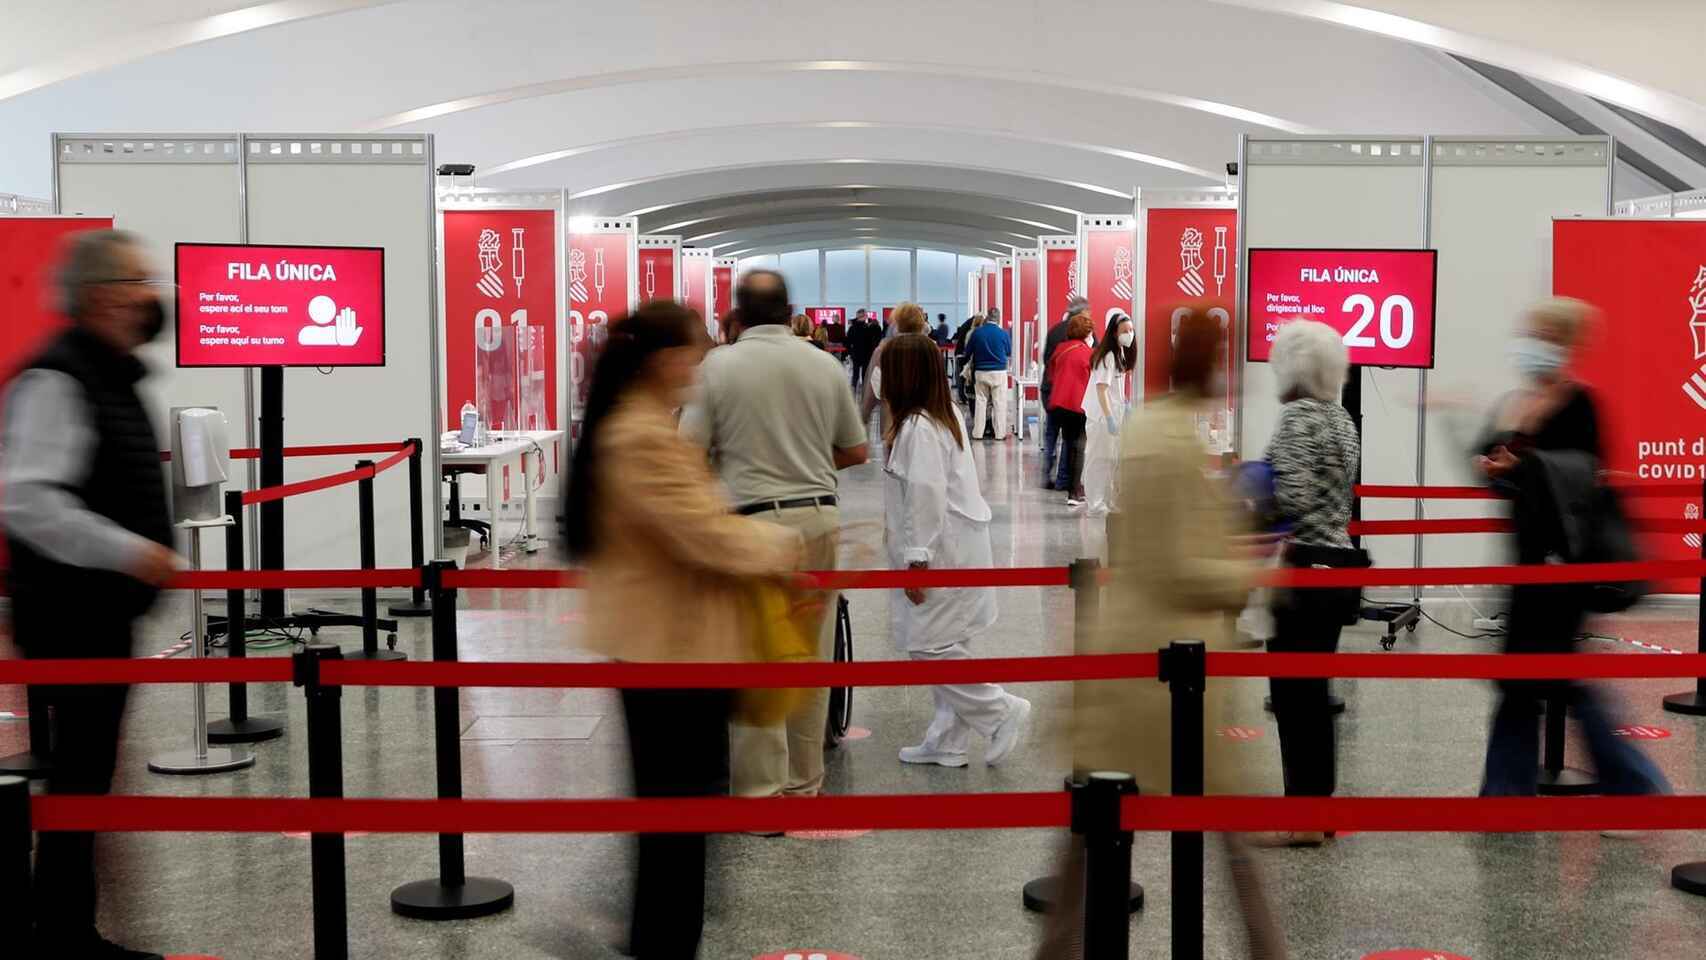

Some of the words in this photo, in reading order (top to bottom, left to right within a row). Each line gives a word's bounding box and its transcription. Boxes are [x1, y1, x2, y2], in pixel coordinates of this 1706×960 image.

[227, 262, 271, 281] FILA
[275, 259, 337, 281] ÚNICA
[1300, 268, 1331, 283] FILA
[1334, 266, 1379, 283] ÚNICA
[199, 292, 214, 302] Per
[216, 292, 240, 303] favor,
[1266, 293, 1279, 302] Per
[199, 305, 229, 314] espere
[244, 304, 253, 313] el
[1342, 293, 1414, 349] 20
[199, 324, 214, 334] Por
[216, 324, 240, 335] favor,
[474, 308, 528, 352] 01
[199, 337, 229, 346] espere
[250, 337, 261, 345] su
[1638, 438, 1686, 460] punt
